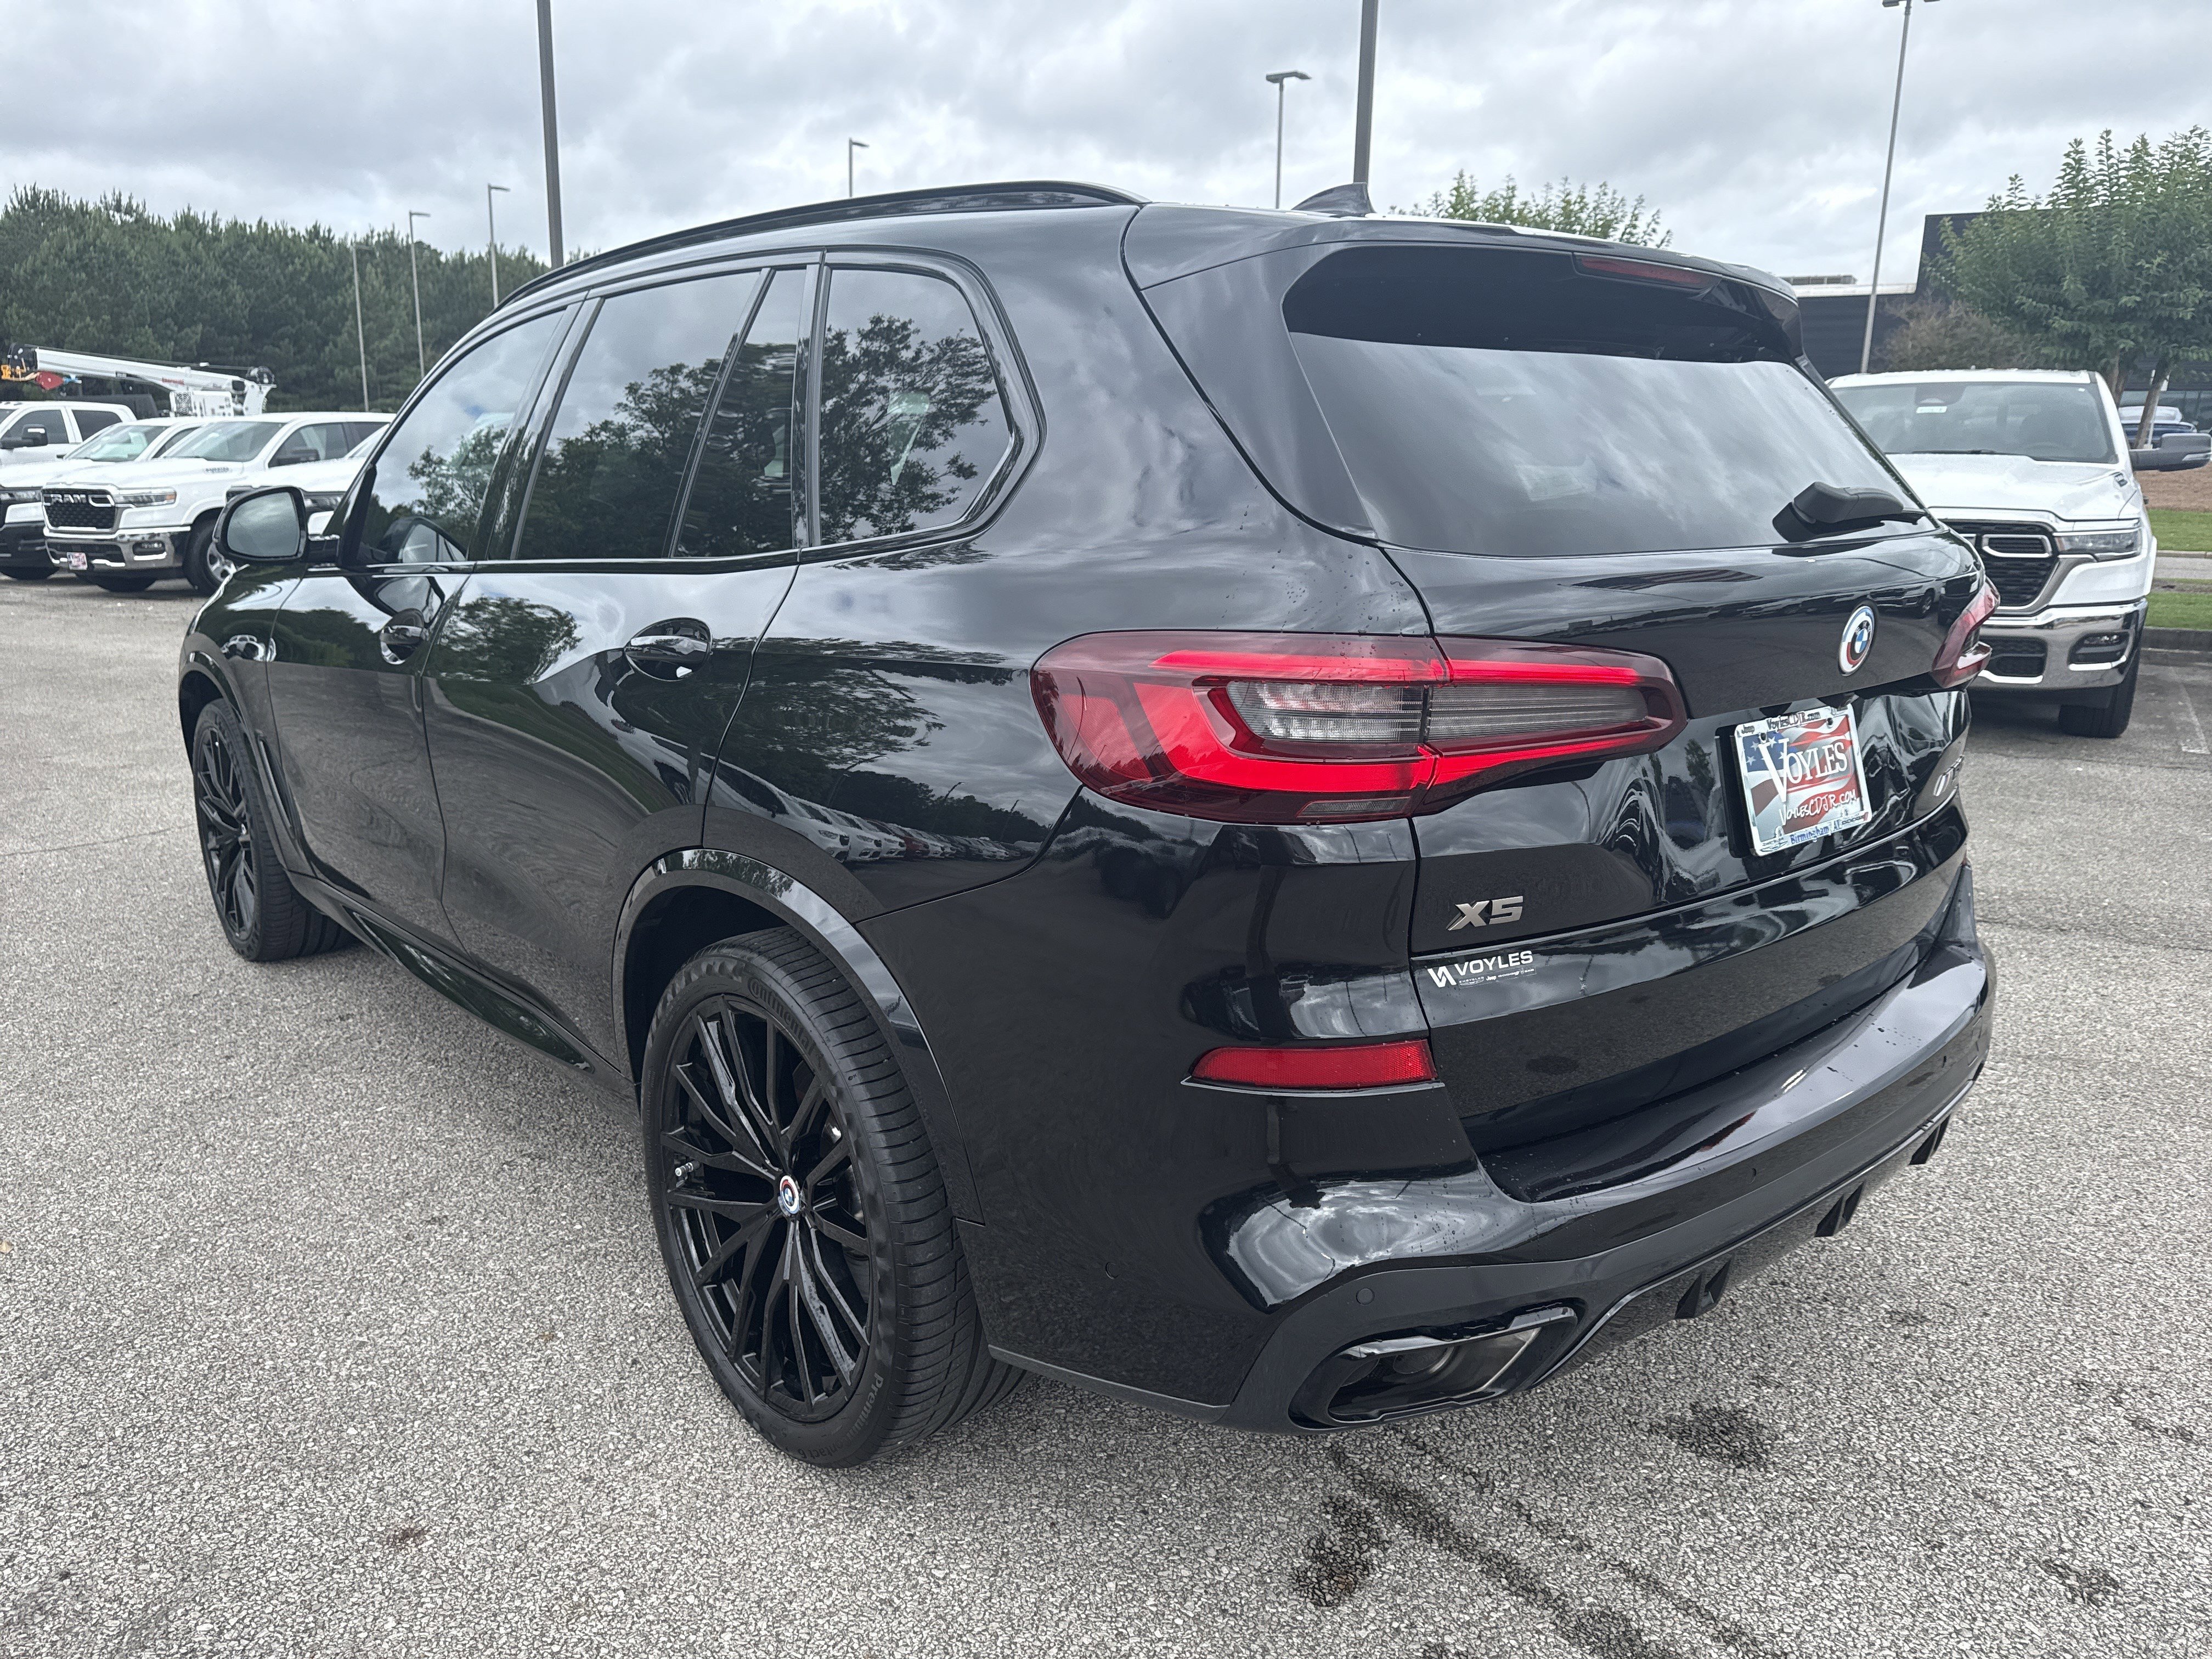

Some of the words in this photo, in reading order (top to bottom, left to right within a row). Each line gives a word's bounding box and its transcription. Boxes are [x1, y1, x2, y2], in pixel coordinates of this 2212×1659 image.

[50, 494, 87, 505] RAM
[1446, 895, 1523, 930] X5
[1454, 950, 1534, 976] VOYLES
[747, 977, 816, 1056] Continental
